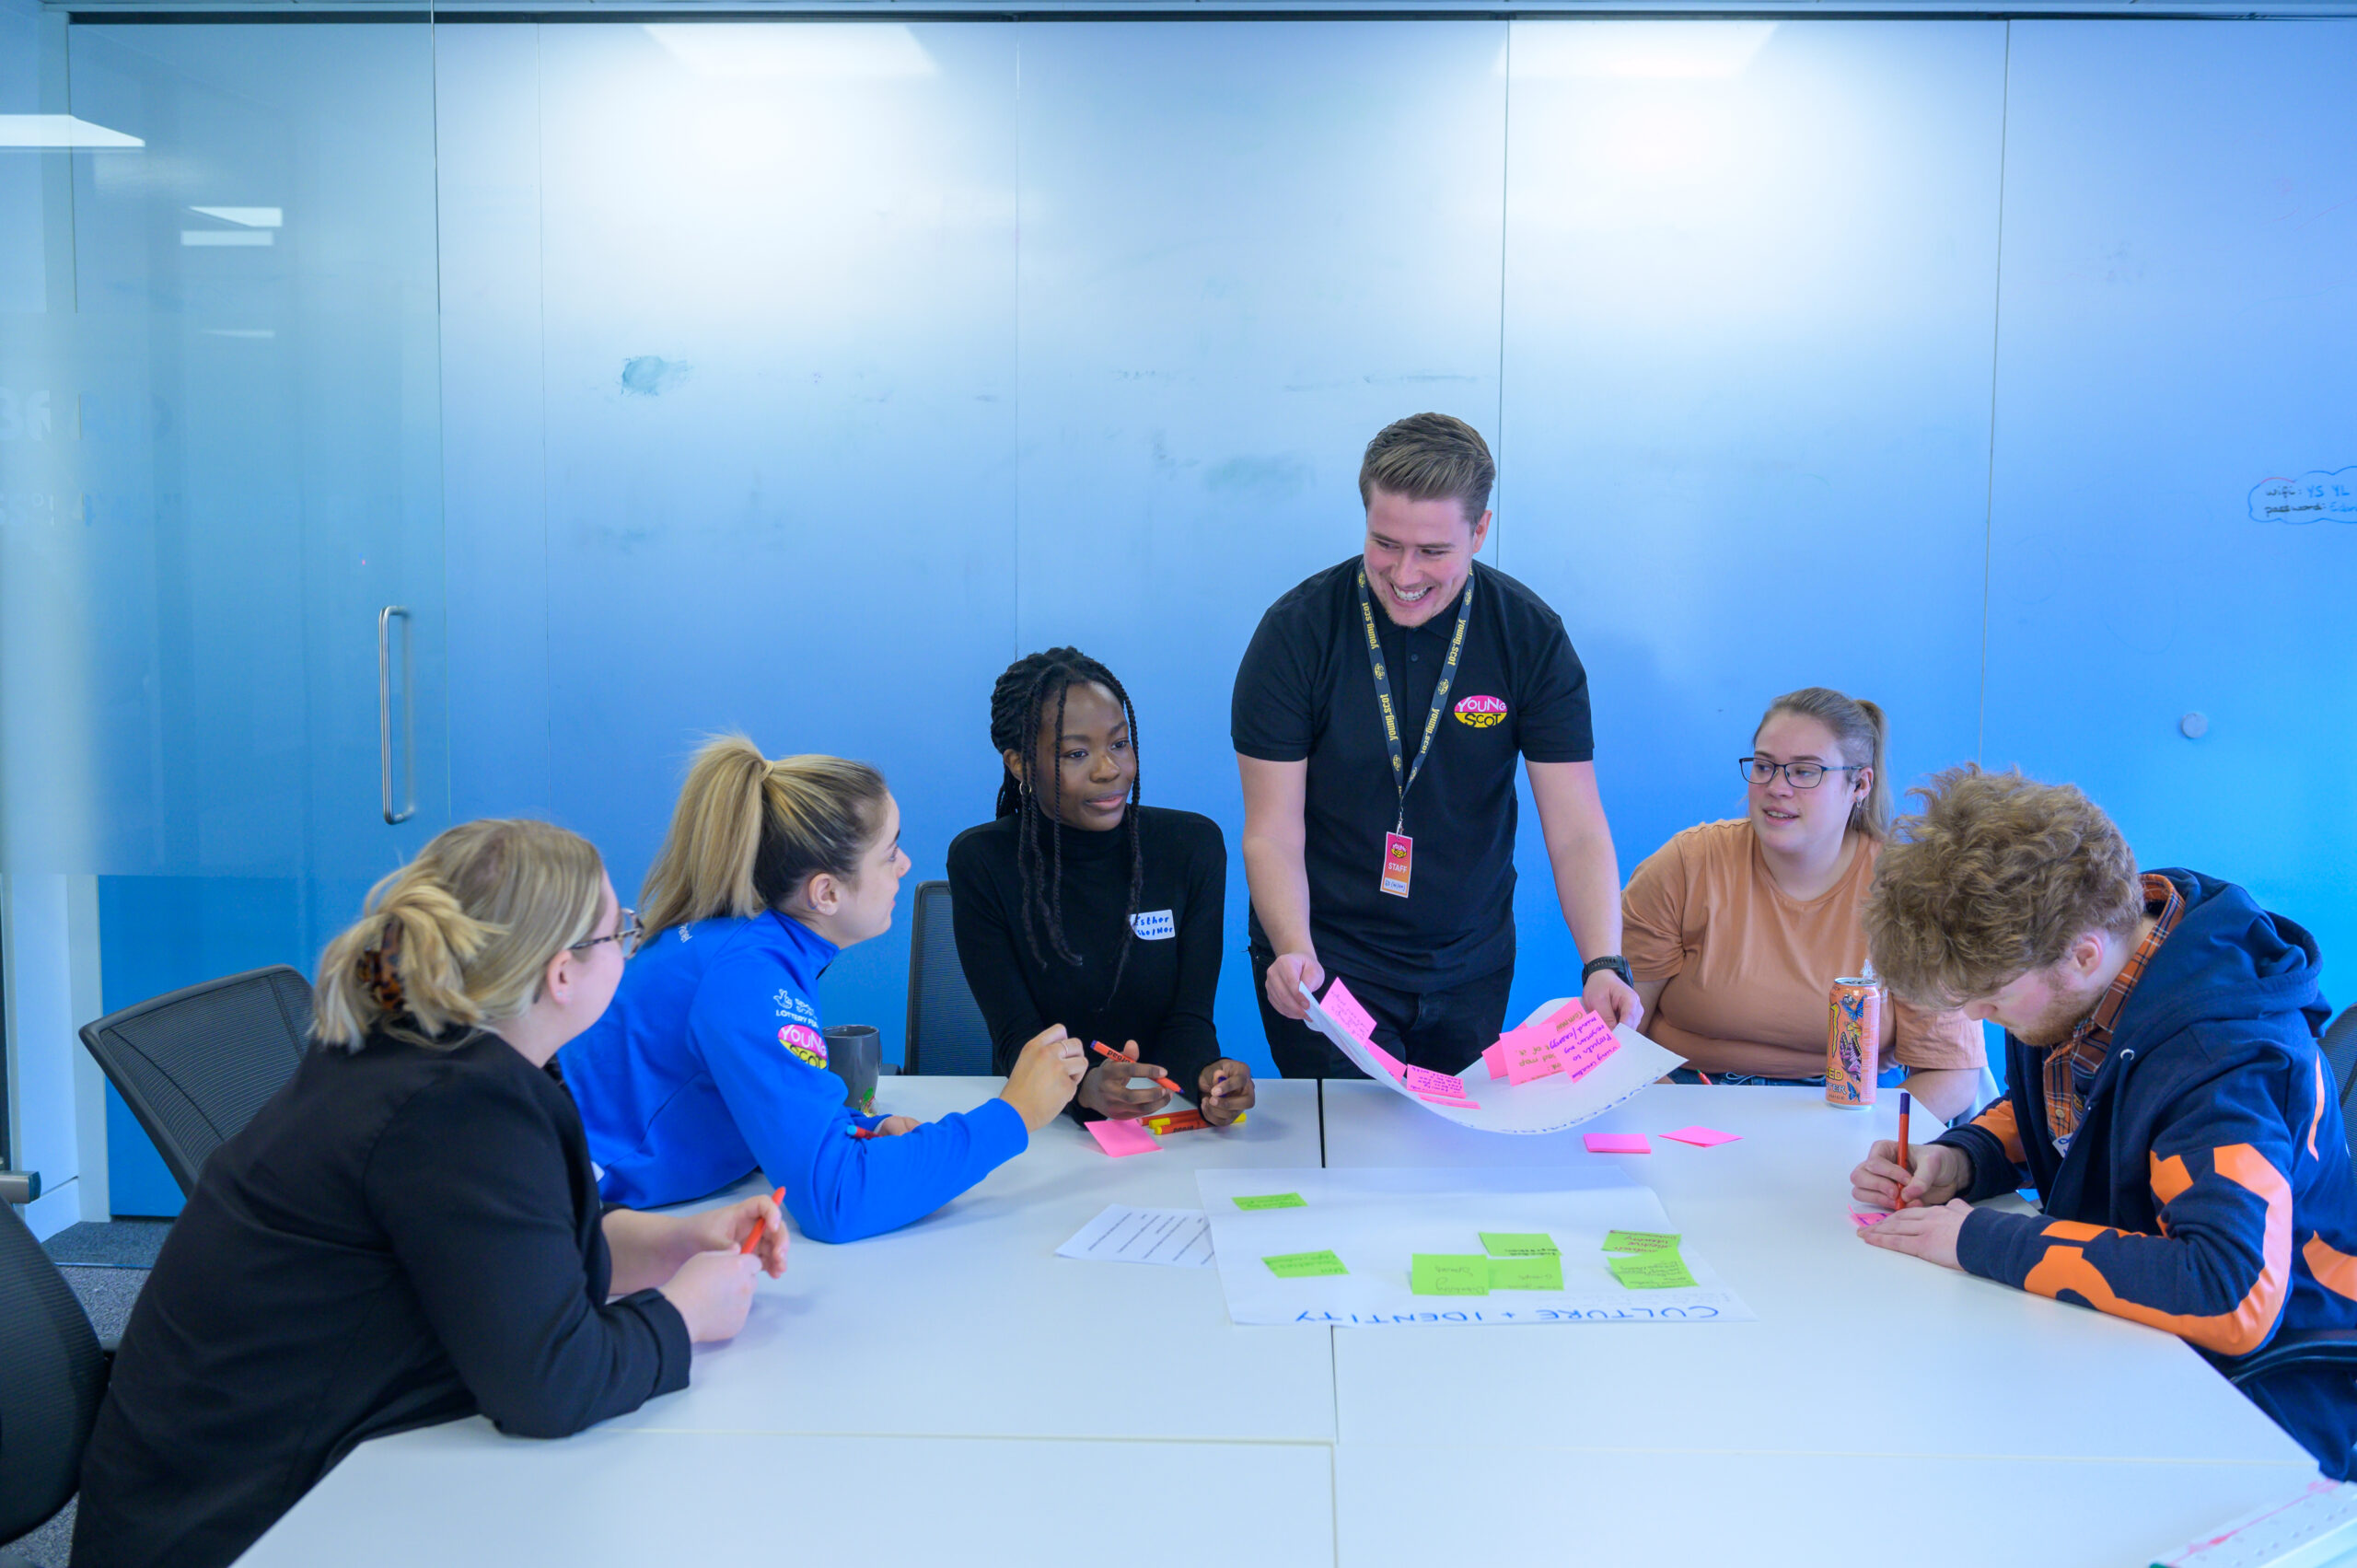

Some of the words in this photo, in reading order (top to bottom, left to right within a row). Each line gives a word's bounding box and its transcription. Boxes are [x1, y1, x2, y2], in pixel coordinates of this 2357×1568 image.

[2307, 484, 2324, 498] YS
[1362, 602, 1379, 649] young.scot
[1447, 619, 1466, 666] young.scot
[1457, 696, 1507, 713] YOUNG
[1380, 693, 1399, 741] young.scot
[1464, 713, 1502, 727] SCOT
[1421, 707, 1440, 754] young.scot
[1388, 863, 1408, 873] STAFF
[775, 1009, 808, 1024] LOTTERY
[781, 1025, 827, 1057] YOUNG
[1295, 1310, 1482, 1325] IDENTITY
[1536, 1306, 1719, 1319] CULTURE
